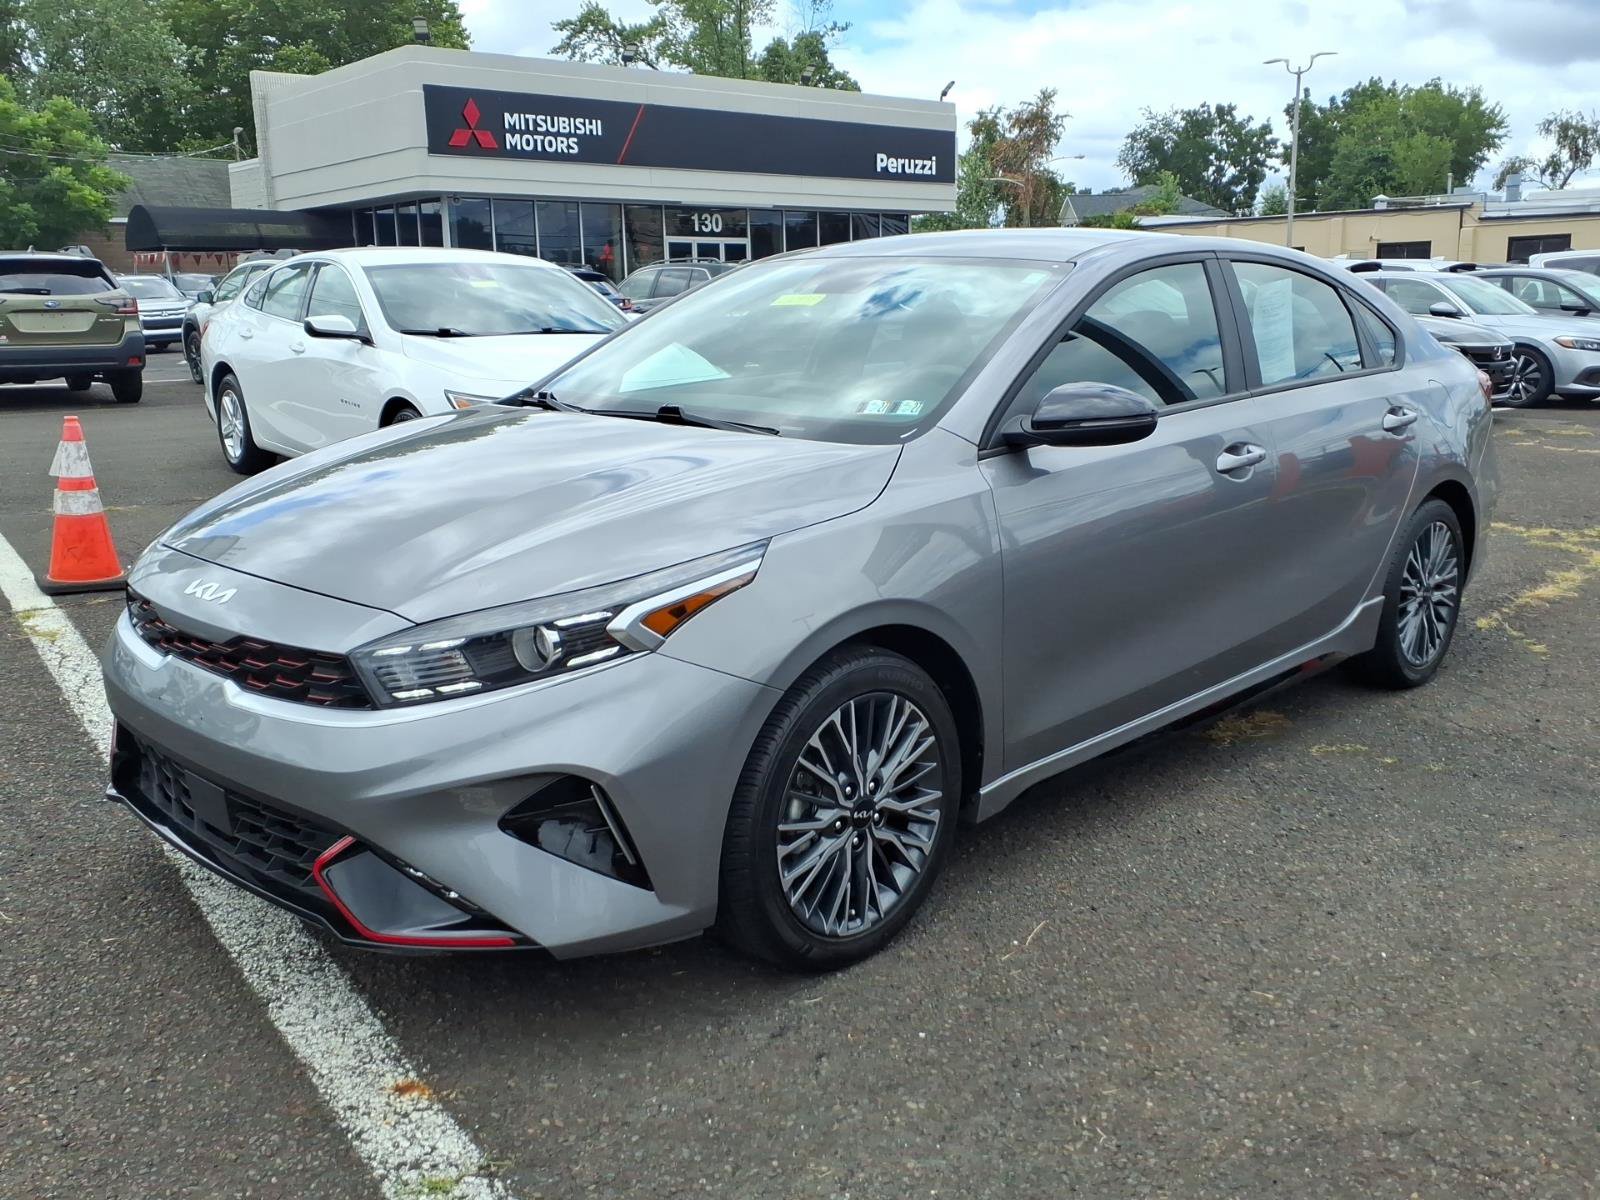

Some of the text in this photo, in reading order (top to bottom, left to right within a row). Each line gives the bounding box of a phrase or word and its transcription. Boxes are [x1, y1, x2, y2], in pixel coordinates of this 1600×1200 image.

[503, 112, 603, 136] MITSUBISHI
[505, 133, 579, 154] MOTORS
[876, 152, 937, 175] Peruzzi
[691, 213, 723, 233] 130
[183, 579, 238, 604] KIA
